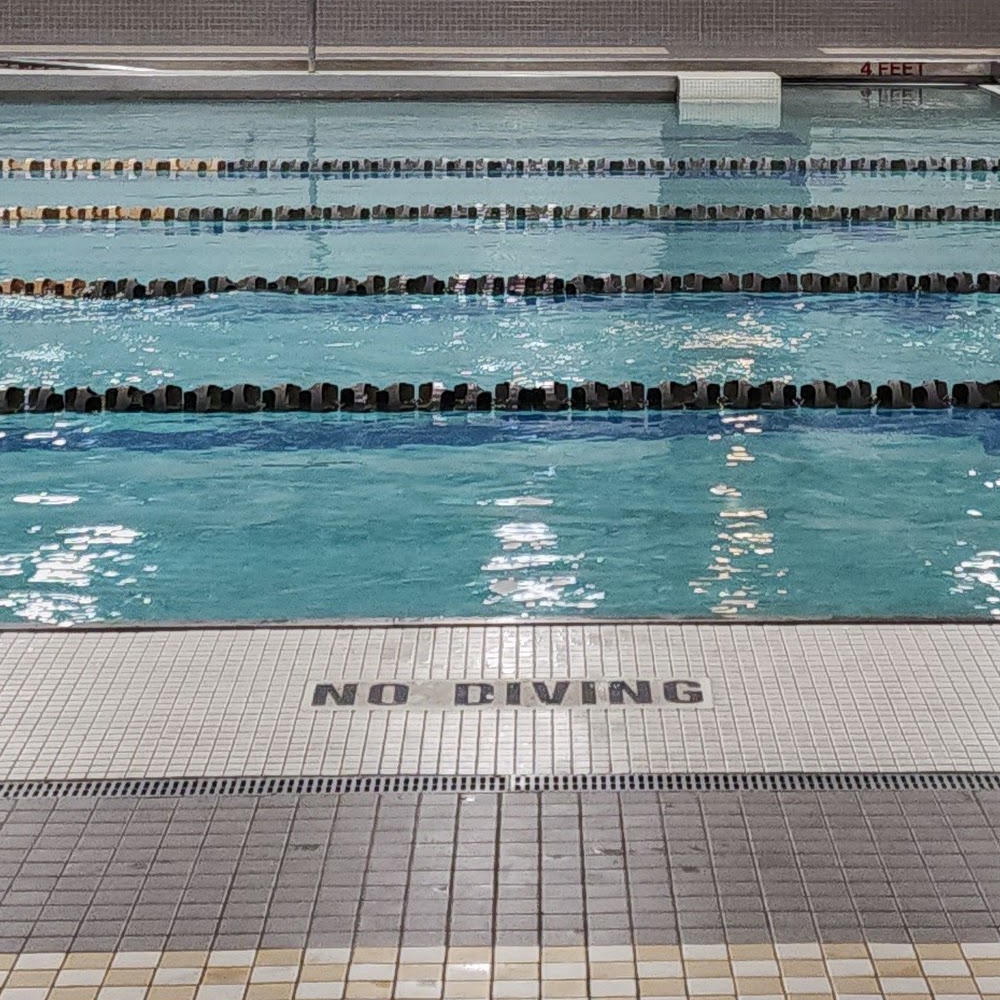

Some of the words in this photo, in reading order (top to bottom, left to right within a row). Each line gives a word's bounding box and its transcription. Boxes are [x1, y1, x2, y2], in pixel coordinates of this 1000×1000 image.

[860, 61, 872, 76] 4
[878, 62, 926, 76] FEET
[311, 683, 410, 706] NO
[453, 680, 704, 706] DIVING
